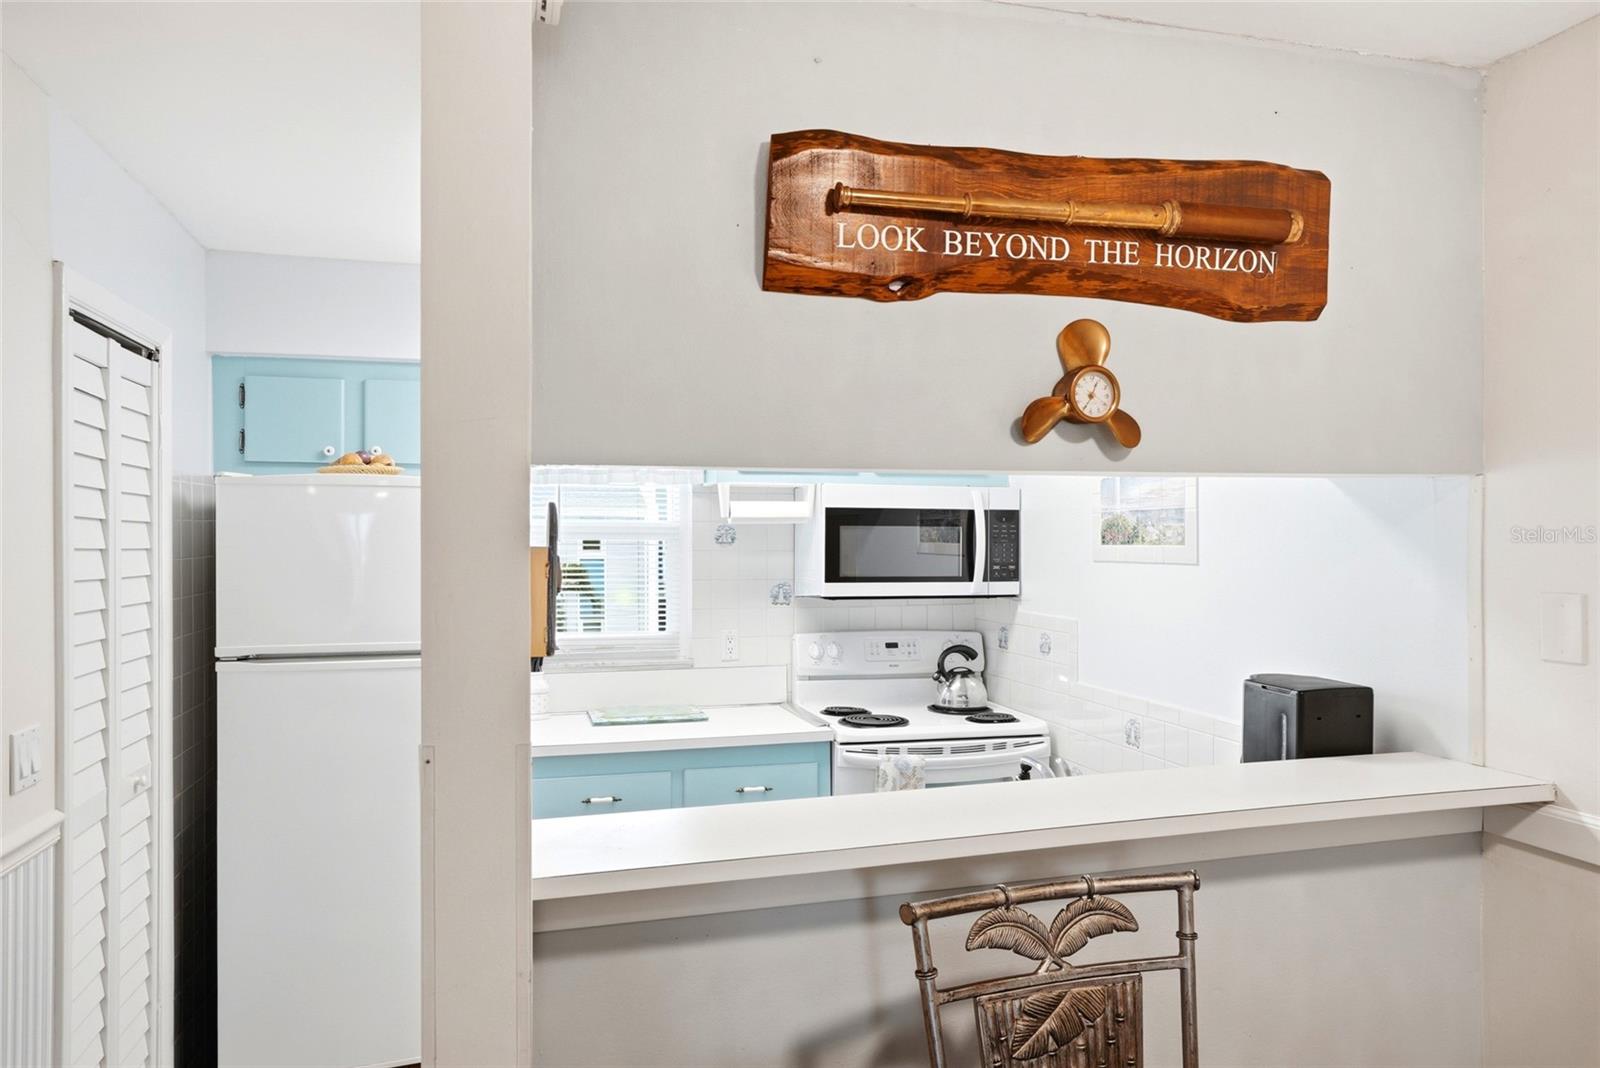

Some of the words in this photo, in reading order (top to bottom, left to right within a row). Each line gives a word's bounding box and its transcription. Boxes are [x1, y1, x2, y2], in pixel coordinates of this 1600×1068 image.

[836, 222, 927, 253] LOOK
[942, 230, 1071, 262] BEYOND
[1084, 238, 1140, 266] THE
[1154, 243, 1278, 275] HORIZON
